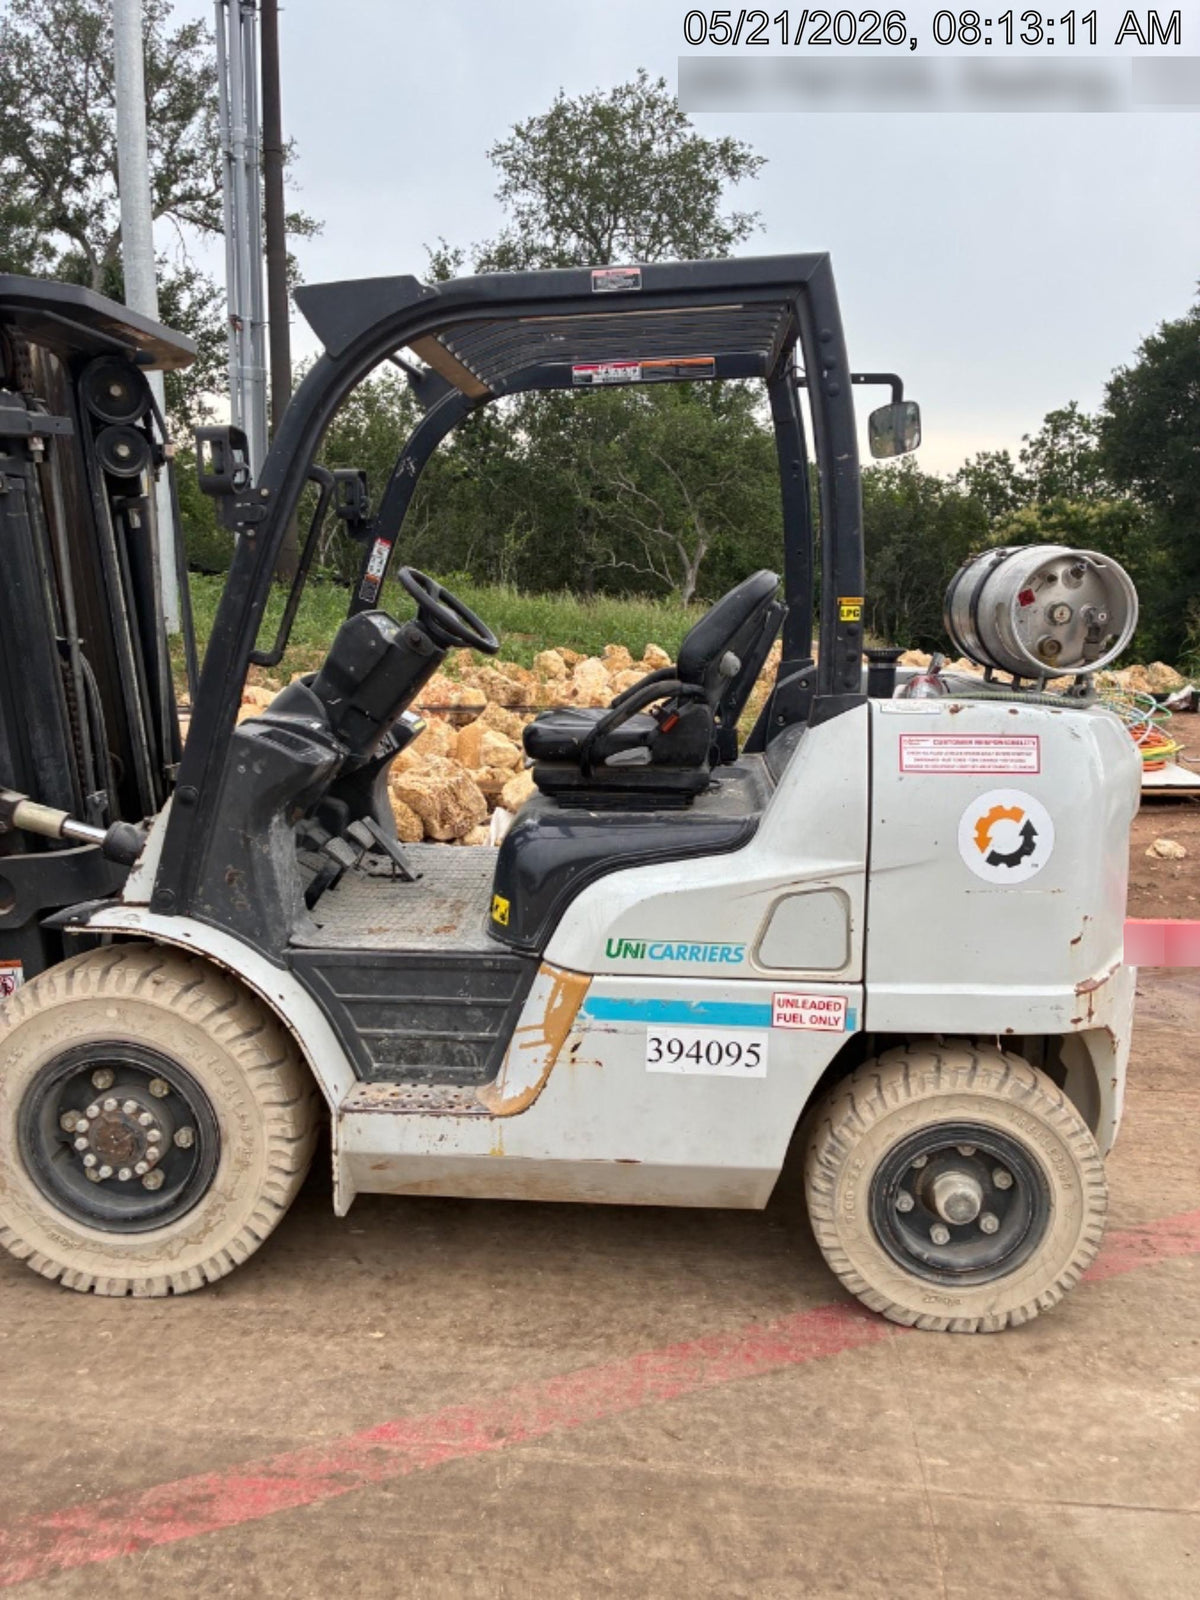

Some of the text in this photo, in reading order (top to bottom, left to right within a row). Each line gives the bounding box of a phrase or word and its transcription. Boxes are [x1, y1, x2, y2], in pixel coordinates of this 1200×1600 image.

[777, 998, 842, 1012] UNLEADED
[776, 1012, 841, 1026] FUEL ONLY
[646, 1036, 762, 1068] 394095
